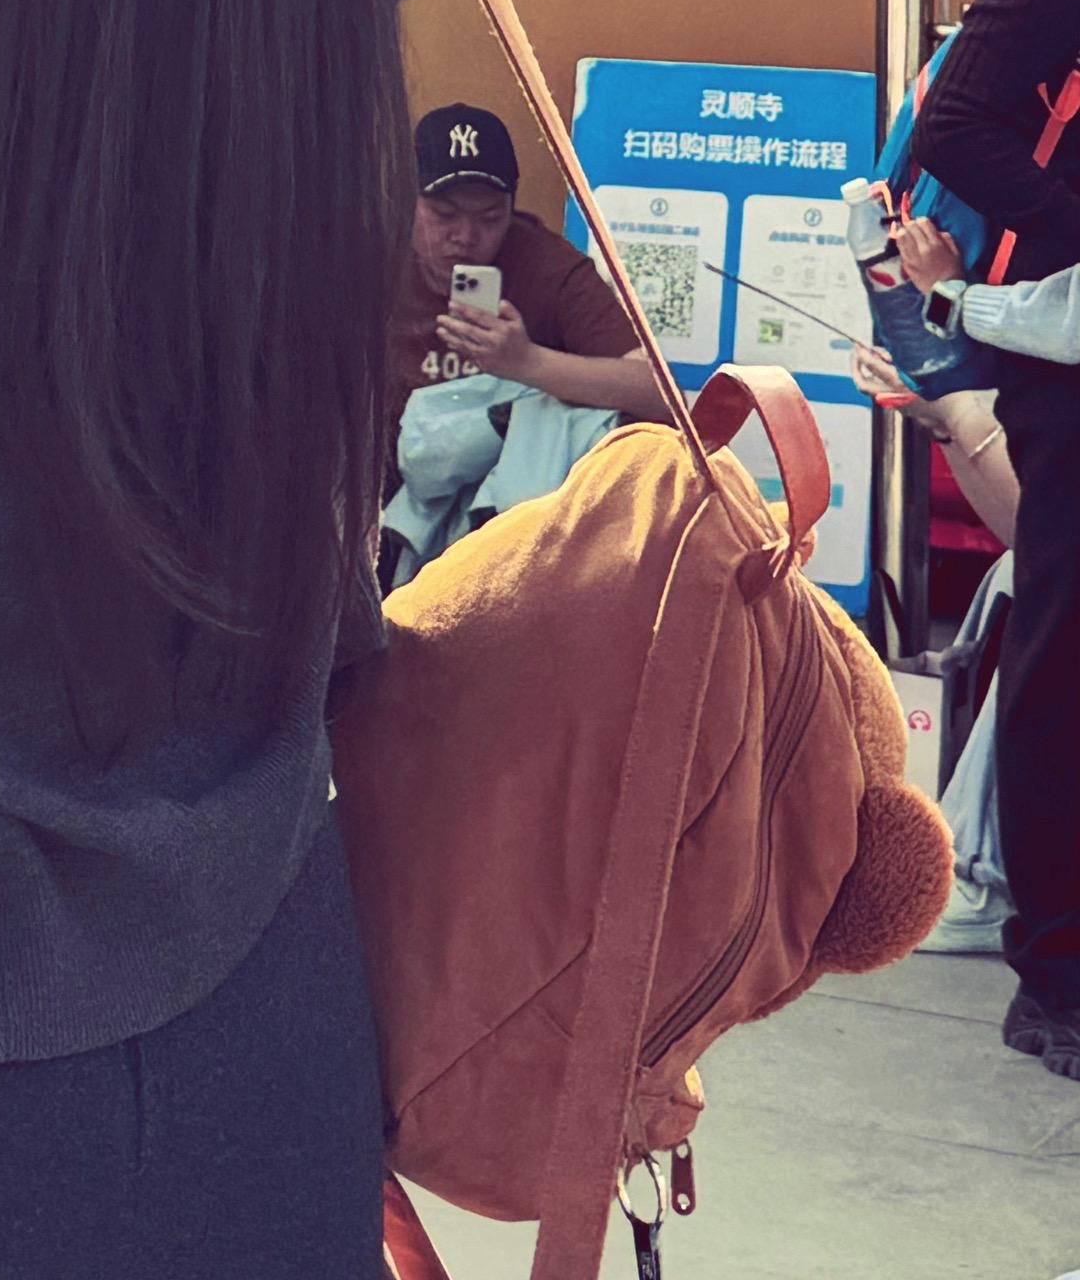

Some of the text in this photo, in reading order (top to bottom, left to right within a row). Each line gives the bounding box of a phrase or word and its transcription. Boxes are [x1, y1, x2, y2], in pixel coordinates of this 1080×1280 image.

[699, 89, 784, 122] 灵顺寺
[449, 124, 480, 158] NY
[623, 128, 848, 171] 扫码购票操作流程
